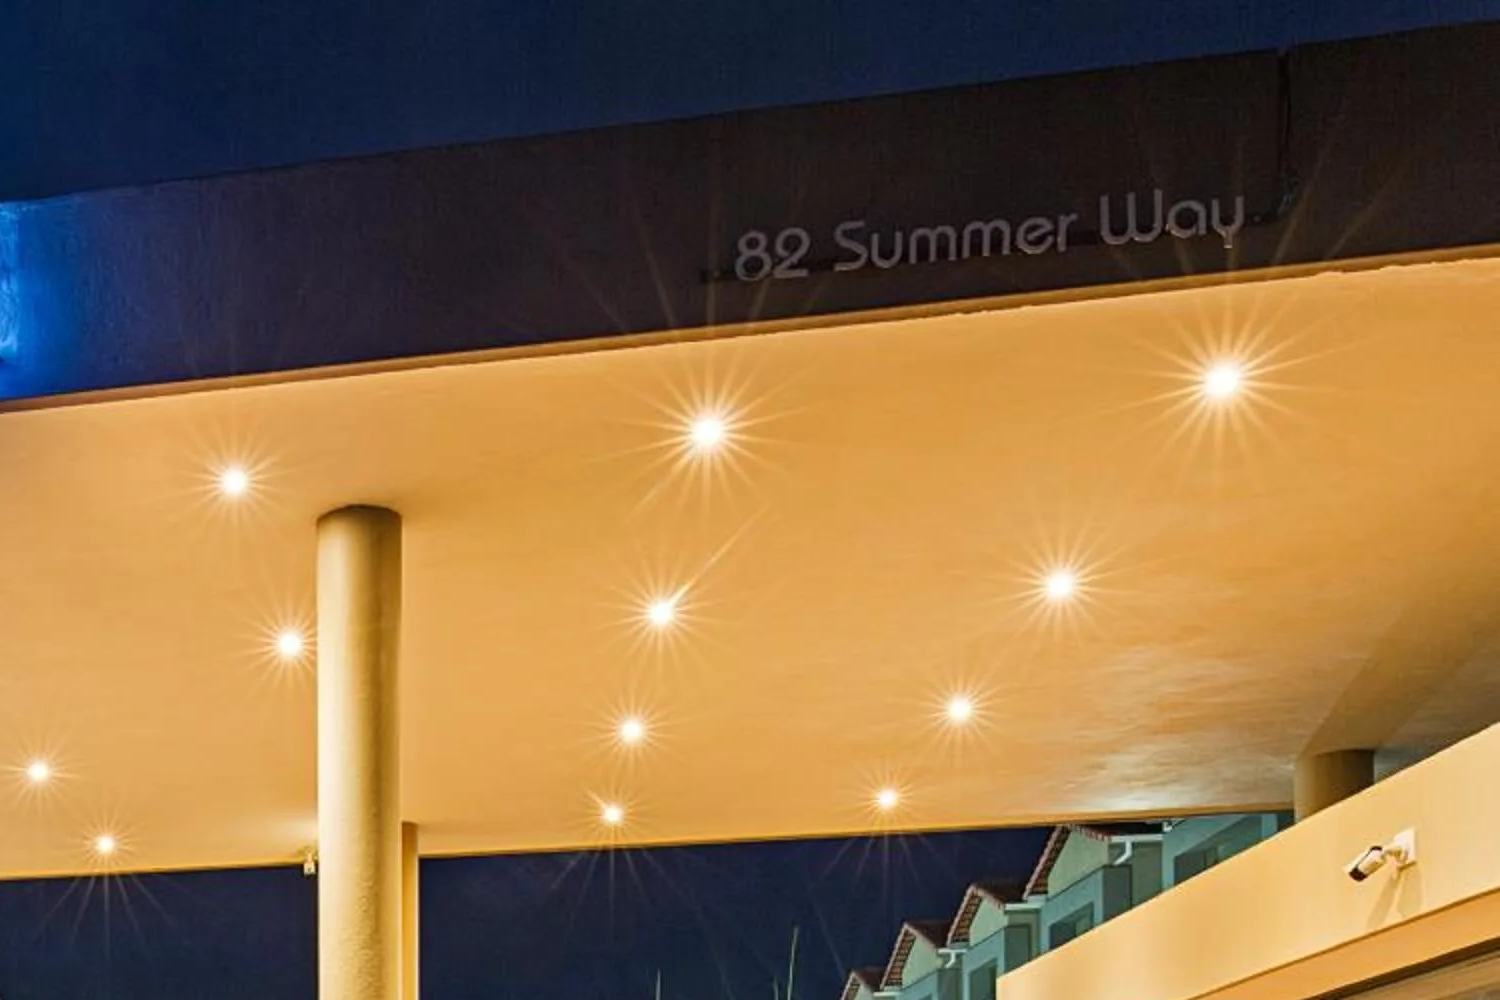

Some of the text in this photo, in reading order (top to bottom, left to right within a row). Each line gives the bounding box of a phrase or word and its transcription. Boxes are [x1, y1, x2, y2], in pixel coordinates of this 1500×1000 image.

[735, 188, 1245, 281] 82 Summer Way
